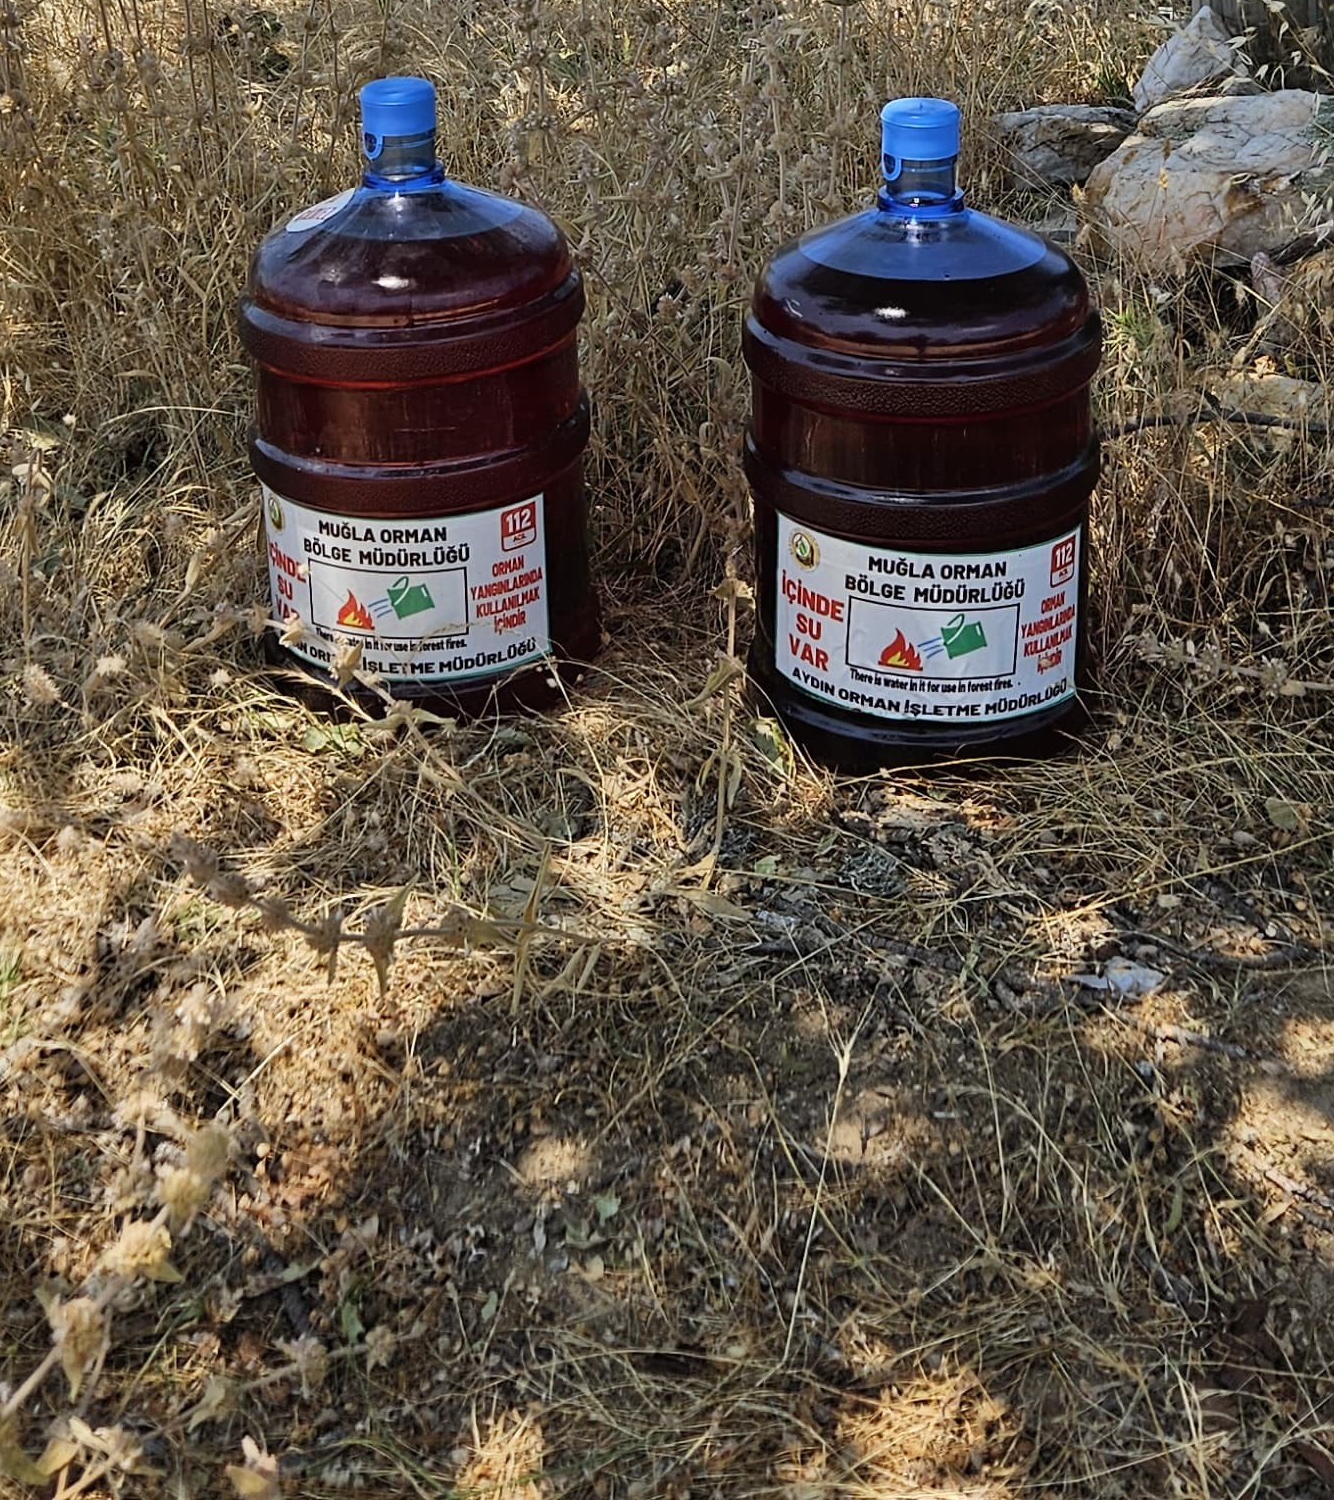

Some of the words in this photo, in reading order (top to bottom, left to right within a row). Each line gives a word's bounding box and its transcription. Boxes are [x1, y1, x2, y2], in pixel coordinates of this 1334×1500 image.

[318, 520, 376, 542] MUĞLA
[380, 527, 447, 544] ORMAN
[506, 508, 532, 534] 112
[303, 537, 352, 563] BÖLGE
[359, 543, 471, 567] MÜDÜRLÜĞÜ
[492, 555, 525, 577] ORMAN
[1054, 542, 1074, 569] 112
[868, 556, 935, 580] MUĞLA
[940, 561, 1007, 580] ORMAN
[277, 574, 293, 600] SU
[782, 569, 845, 623] İÇİNDE
[844, 574, 906, 600] BÖLGE
[913, 578, 1025, 604] MÜDÜRLÜĞÜ
[476, 587, 540, 618] KULLANILMAK
[796, 612, 822, 641] SU
[439, 636, 537, 673] MÜDÜRLÜĞÜ
[789, 632, 829, 672] VAR
[792, 667, 835, 696] AYDIN
[838, 688, 900, 713] ORMAN
[904, 699, 981, 716] İŞLETME
[850, 667, 873, 685] There
[927, 681, 940, 693] for
